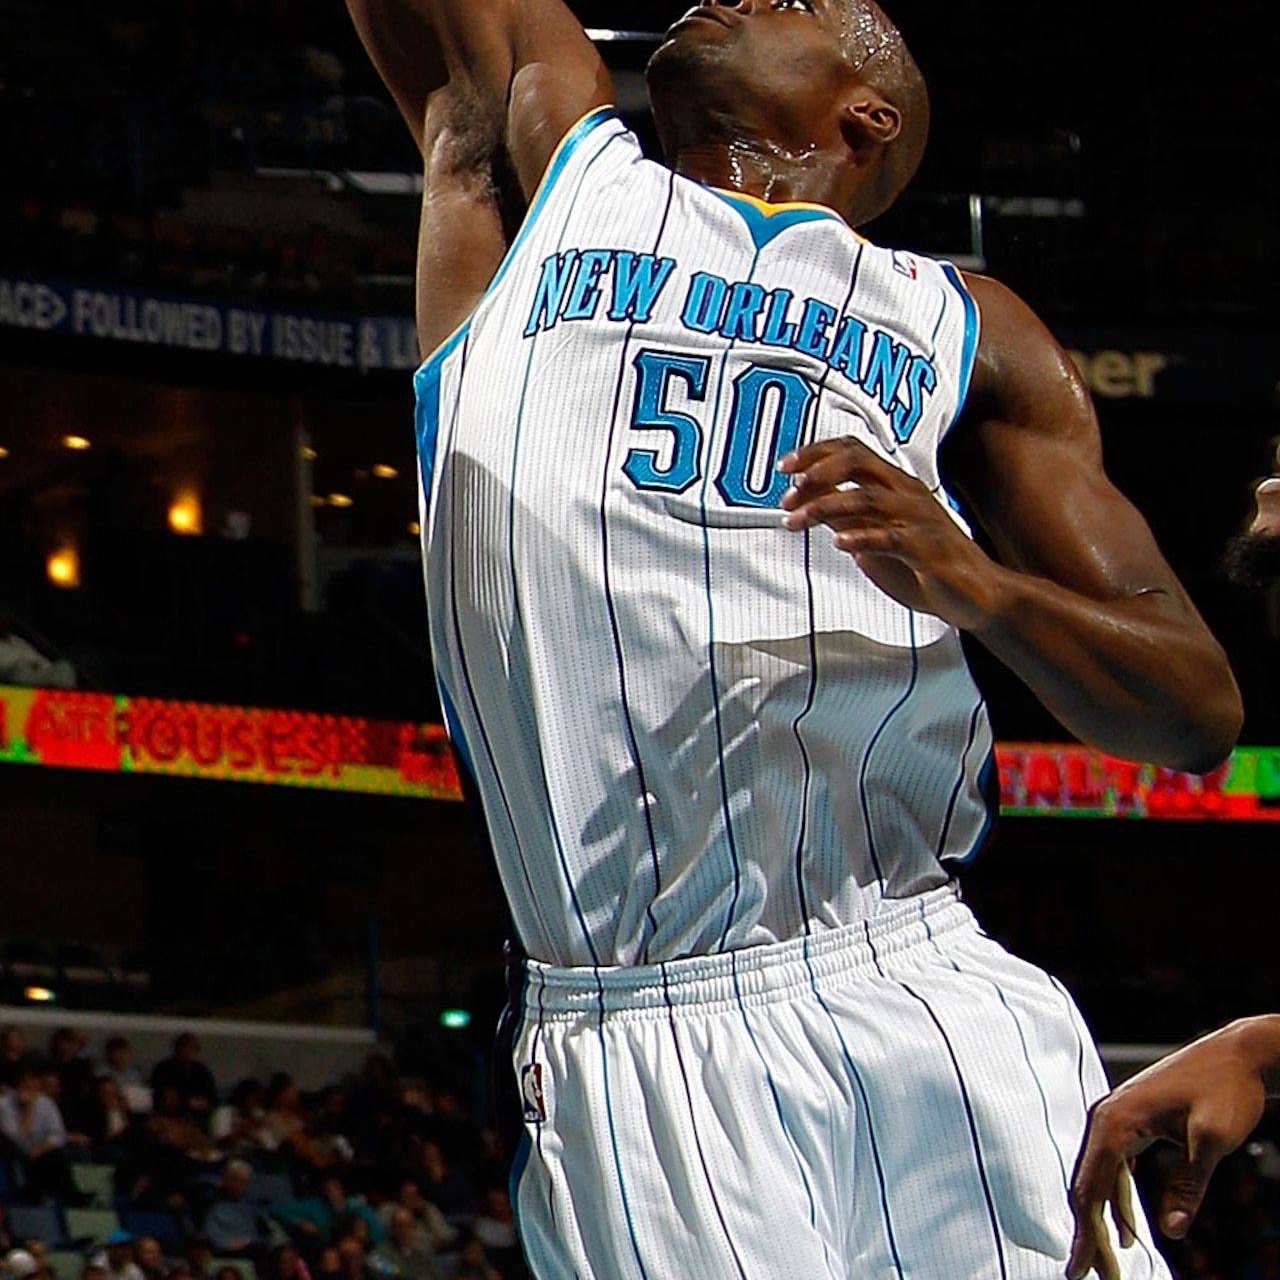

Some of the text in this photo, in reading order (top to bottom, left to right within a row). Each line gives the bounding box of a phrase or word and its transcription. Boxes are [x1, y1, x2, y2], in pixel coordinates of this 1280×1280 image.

[73, 287, 223, 353] FOLLOWED
[227, 307, 266, 357] BY
[270, 312, 355, 368] ISSUE
[522, 247, 938, 445] NEW ORLEANS
[621, 347, 820, 510] 50
